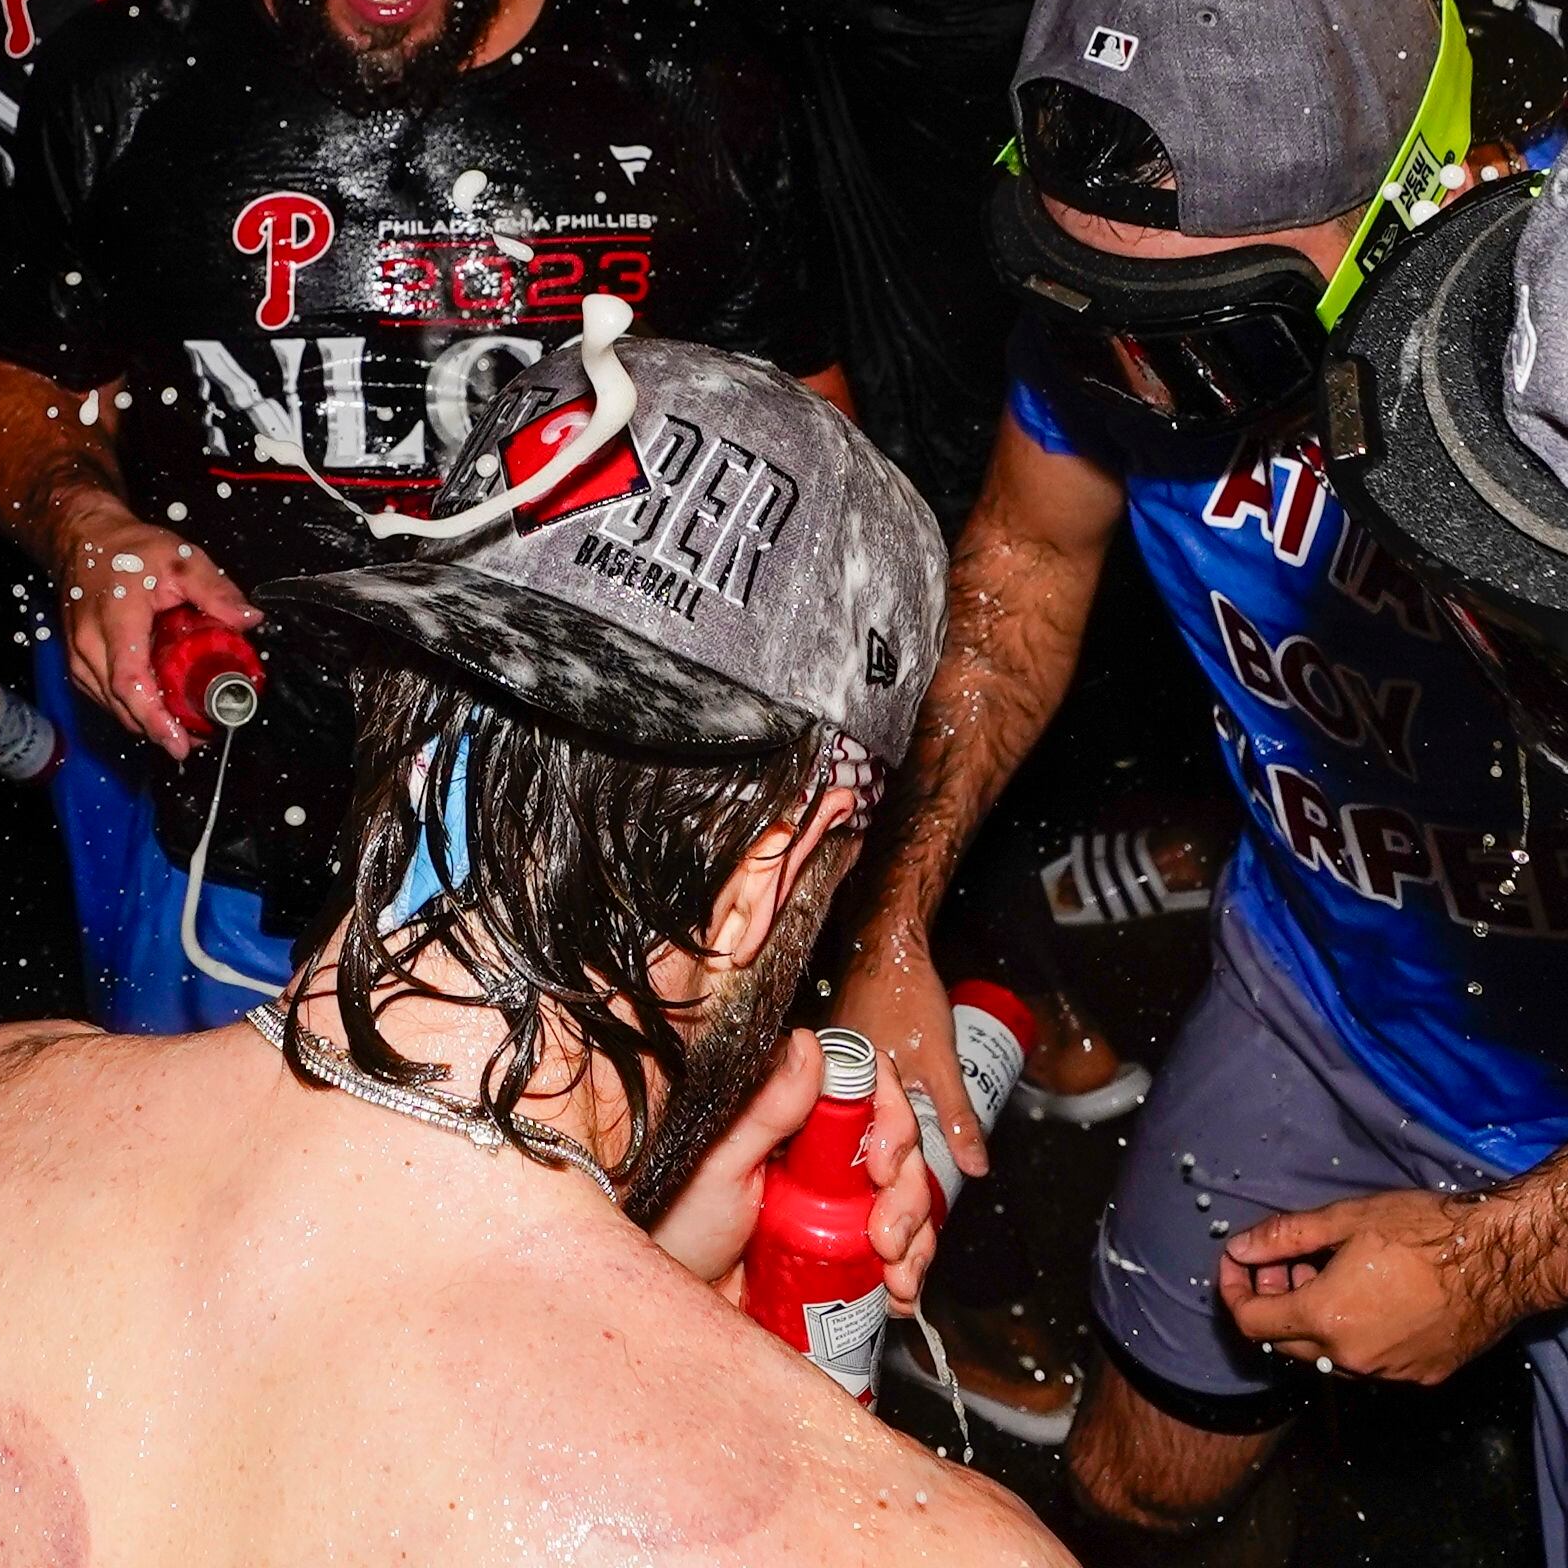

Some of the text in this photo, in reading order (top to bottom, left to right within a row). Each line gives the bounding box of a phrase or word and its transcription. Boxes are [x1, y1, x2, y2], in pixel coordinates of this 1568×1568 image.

[1398, 150, 1426, 205] NEW
[233, 190, 334, 331] P
[378, 217, 551, 236] PHILADPHIA
[377, 251, 652, 310] 2023
[184, 336, 567, 468] NLC
[573, 533, 705, 623] BASEBALL
[1210, 590, 1422, 782] BOY
